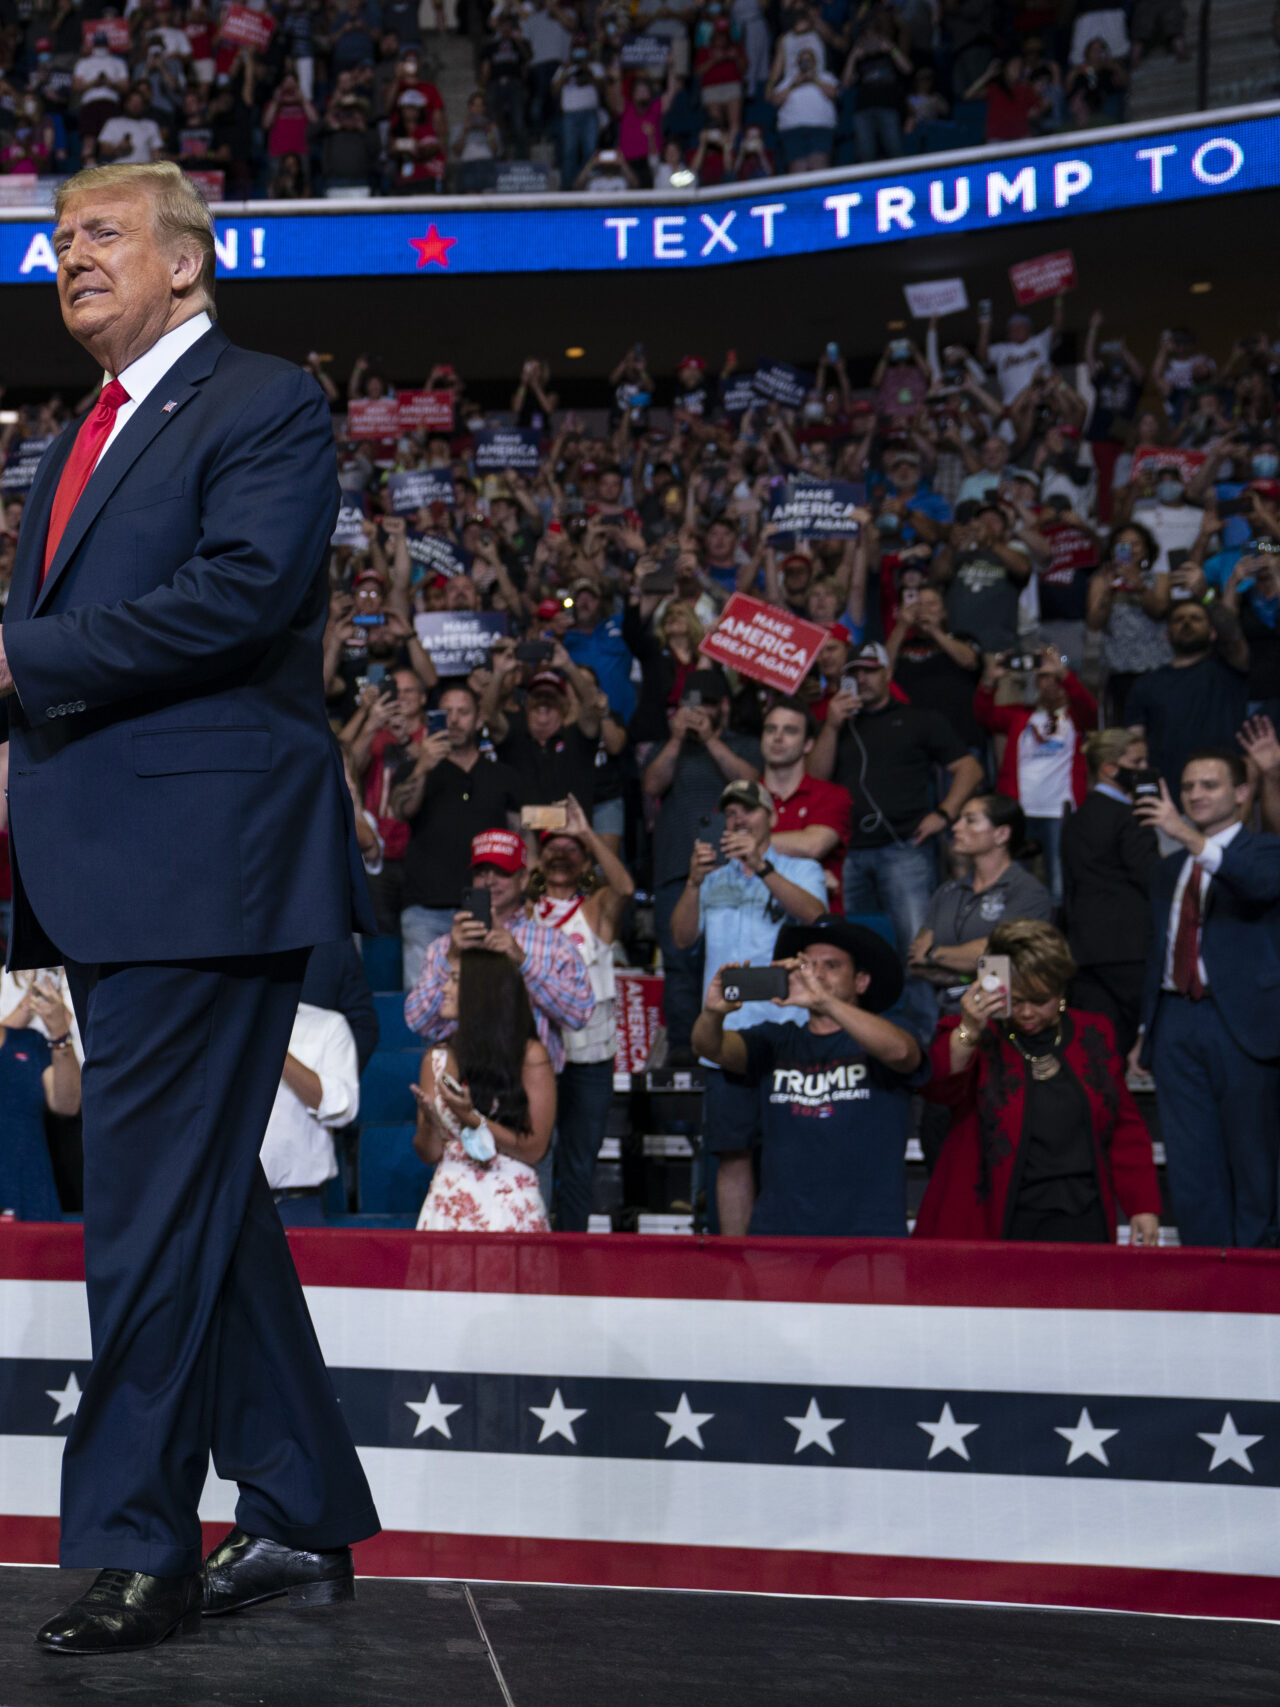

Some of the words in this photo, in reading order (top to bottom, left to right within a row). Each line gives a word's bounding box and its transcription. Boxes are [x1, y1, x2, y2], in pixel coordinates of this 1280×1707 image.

[604, 203, 785, 260] TEXT
[823, 159, 1092, 239] TRUMP
[1137, 137, 1244, 193] TO
[19, 228, 265, 276] AN!
[718, 615, 808, 667] AMERICA
[751, 611, 795, 640] MAKE
[710, 631, 757, 660] GREAT
[754, 652, 801, 680] AGAIN
[625, 980, 649, 1074] AMERICA
[773, 1063, 867, 1097] TRUMP
